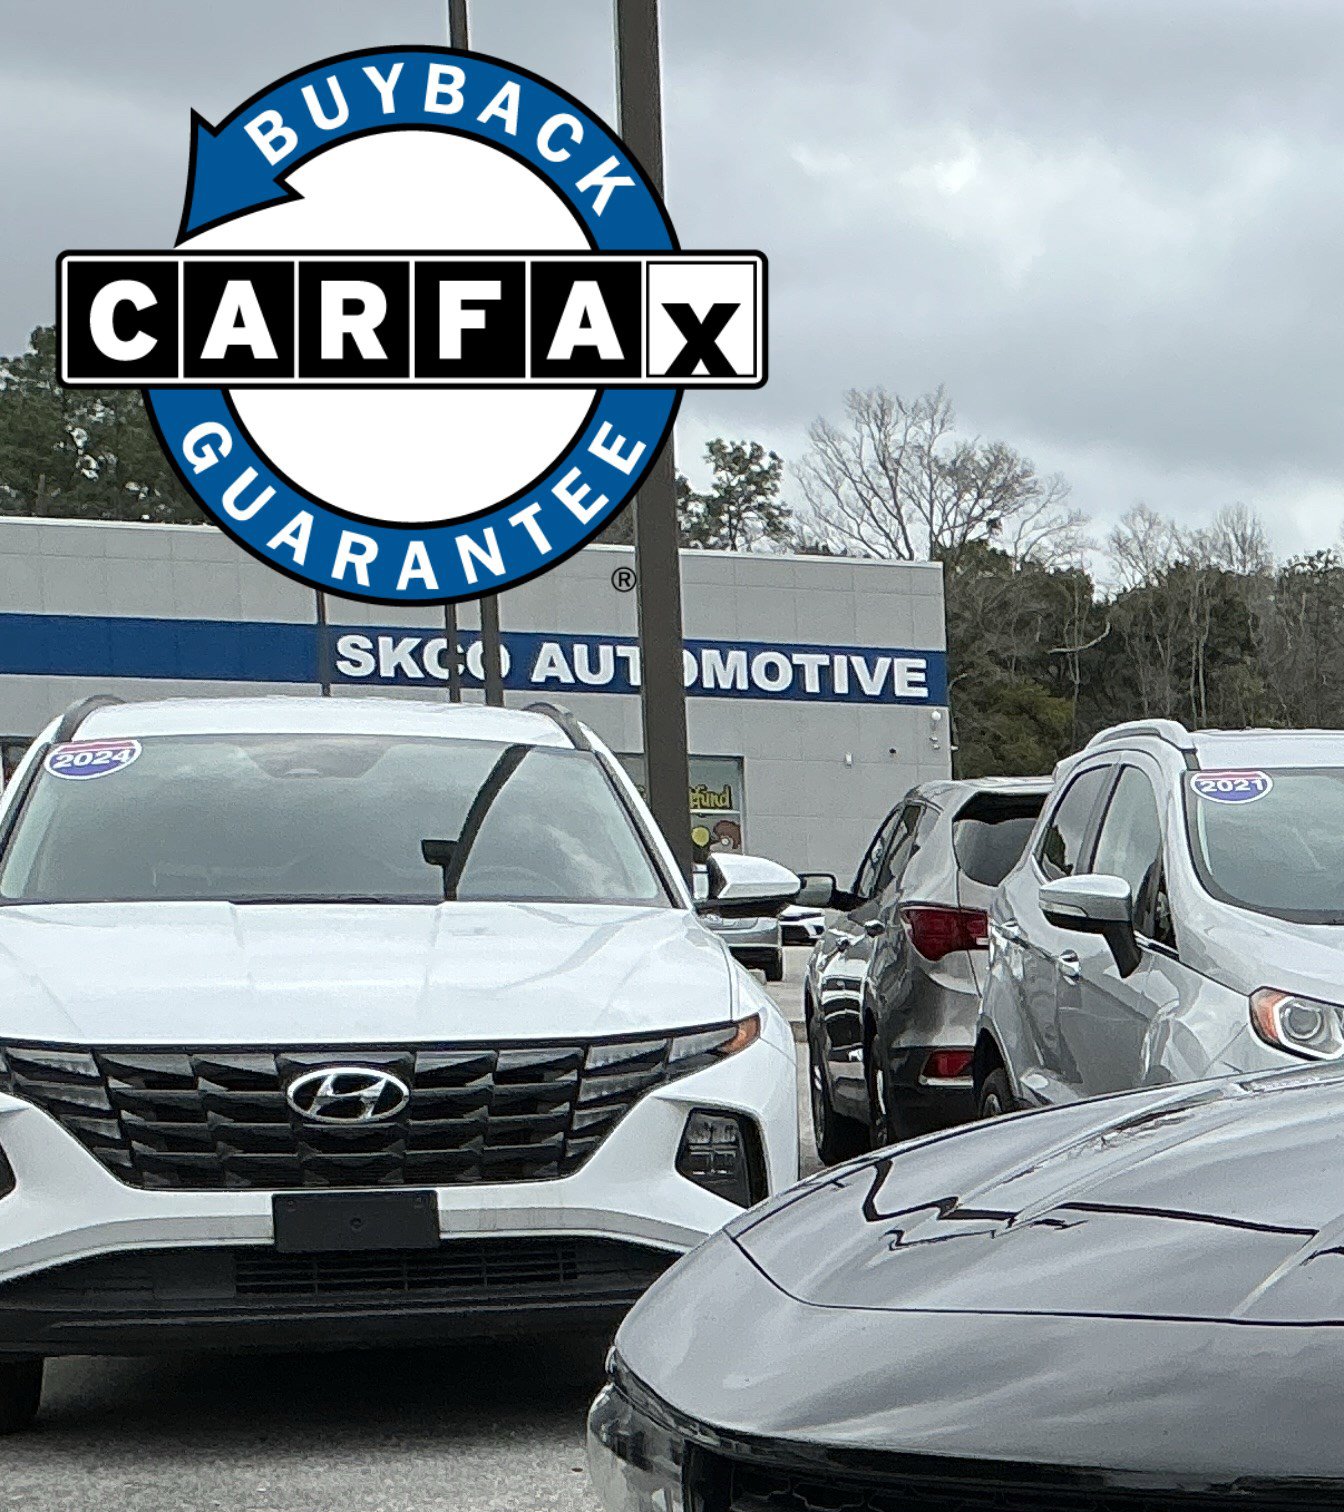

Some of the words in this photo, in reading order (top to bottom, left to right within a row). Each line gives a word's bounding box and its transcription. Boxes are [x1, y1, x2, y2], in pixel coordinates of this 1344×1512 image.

[335, 634, 511, 681] SKCO
[531, 641, 929, 698] AUTMOTIVE
[53, 749, 131, 769] 2024
[1200, 779, 1264, 793] 2021
